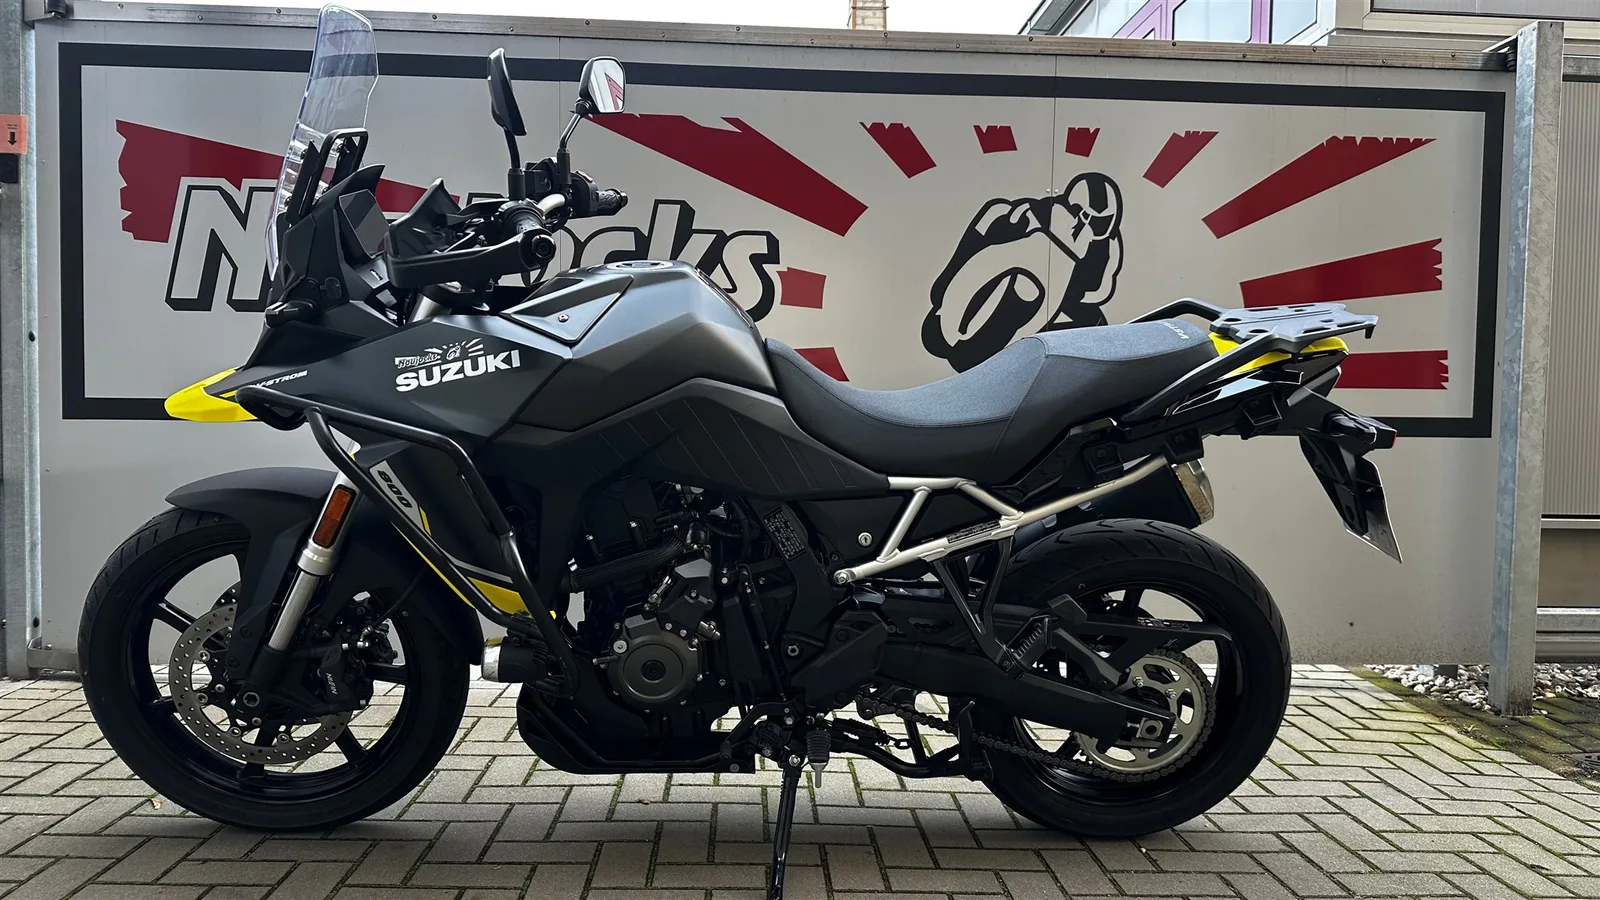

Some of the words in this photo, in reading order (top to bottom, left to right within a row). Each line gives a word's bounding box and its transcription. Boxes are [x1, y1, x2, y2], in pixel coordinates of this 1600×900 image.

[165, 185, 779, 322] Nocks
[395, 349, 521, 392] SUZUKI
[377, 470, 413, 508] 800
